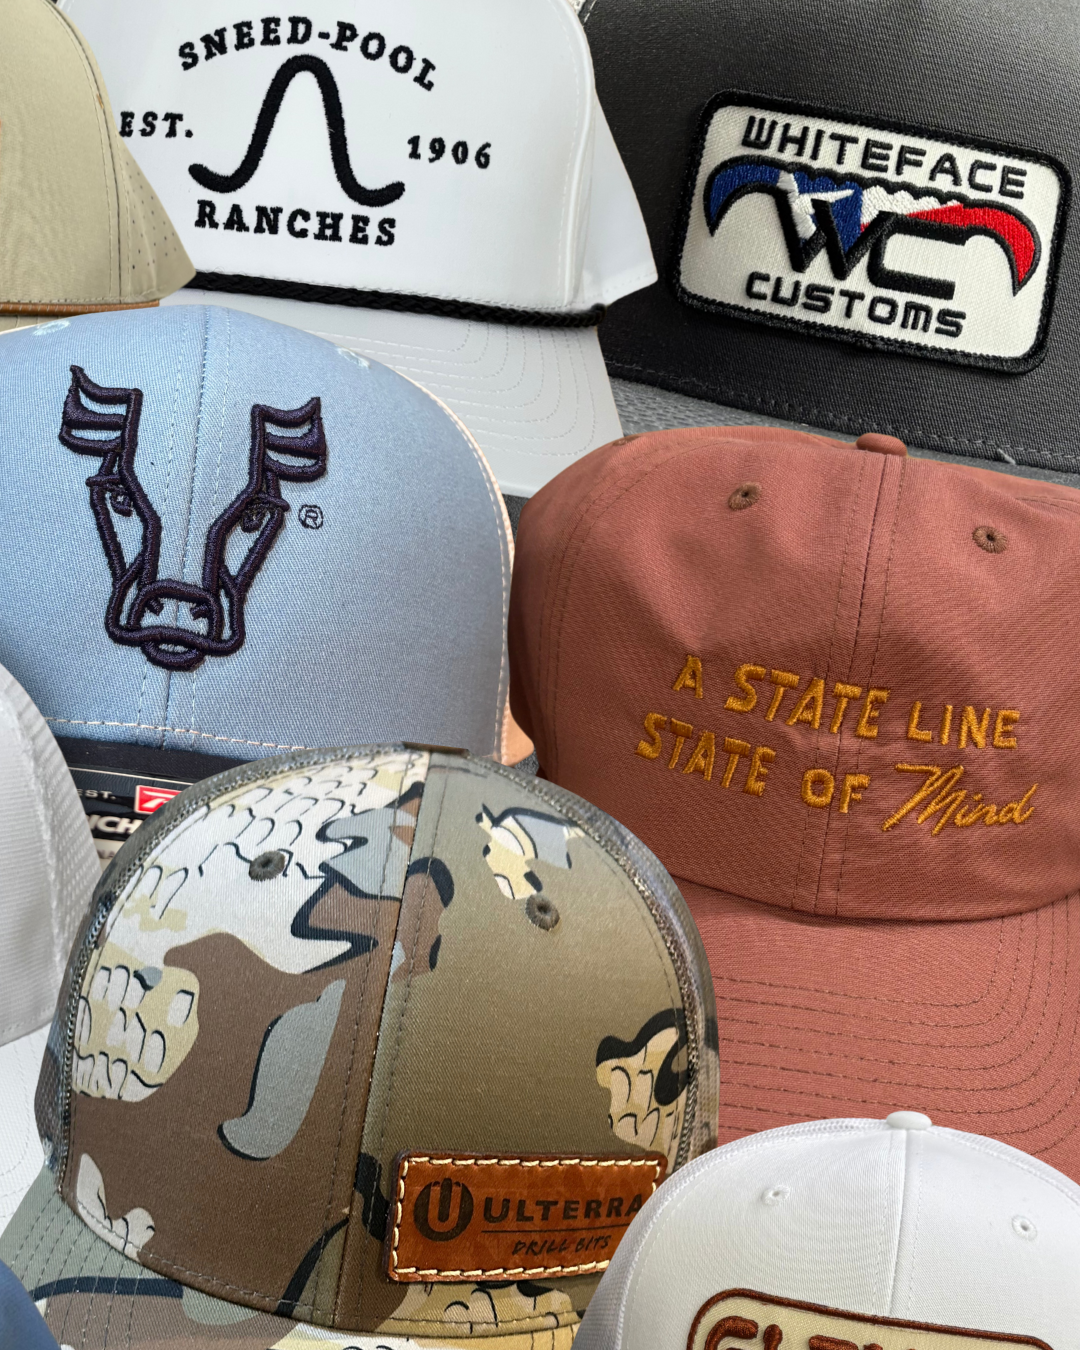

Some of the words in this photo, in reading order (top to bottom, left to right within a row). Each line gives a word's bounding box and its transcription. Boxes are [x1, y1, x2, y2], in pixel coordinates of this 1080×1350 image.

[178, 16, 436, 91] SNEED-POOL
[119, 111, 194, 138] EST.
[407, 135, 492, 169] 1906
[741, 115, 1027, 199] WHITEFACE
[194, 199, 396, 246] RANCHES
[745, 271, 967, 338] CUSTOMS
[672, 654, 703, 699] A
[724, 663, 890, 739] STATE
[907, 701, 1020, 750] LINE
[634, 712, 776, 797] STATE
[801, 768, 871, 814] OF
[881, 763, 1039, 836] Mind
[483, 1194, 643, 1224] ULTERRA
[512, 1239, 569, 1256] DRILL
[575, 1235, 612, 1253] BITS
